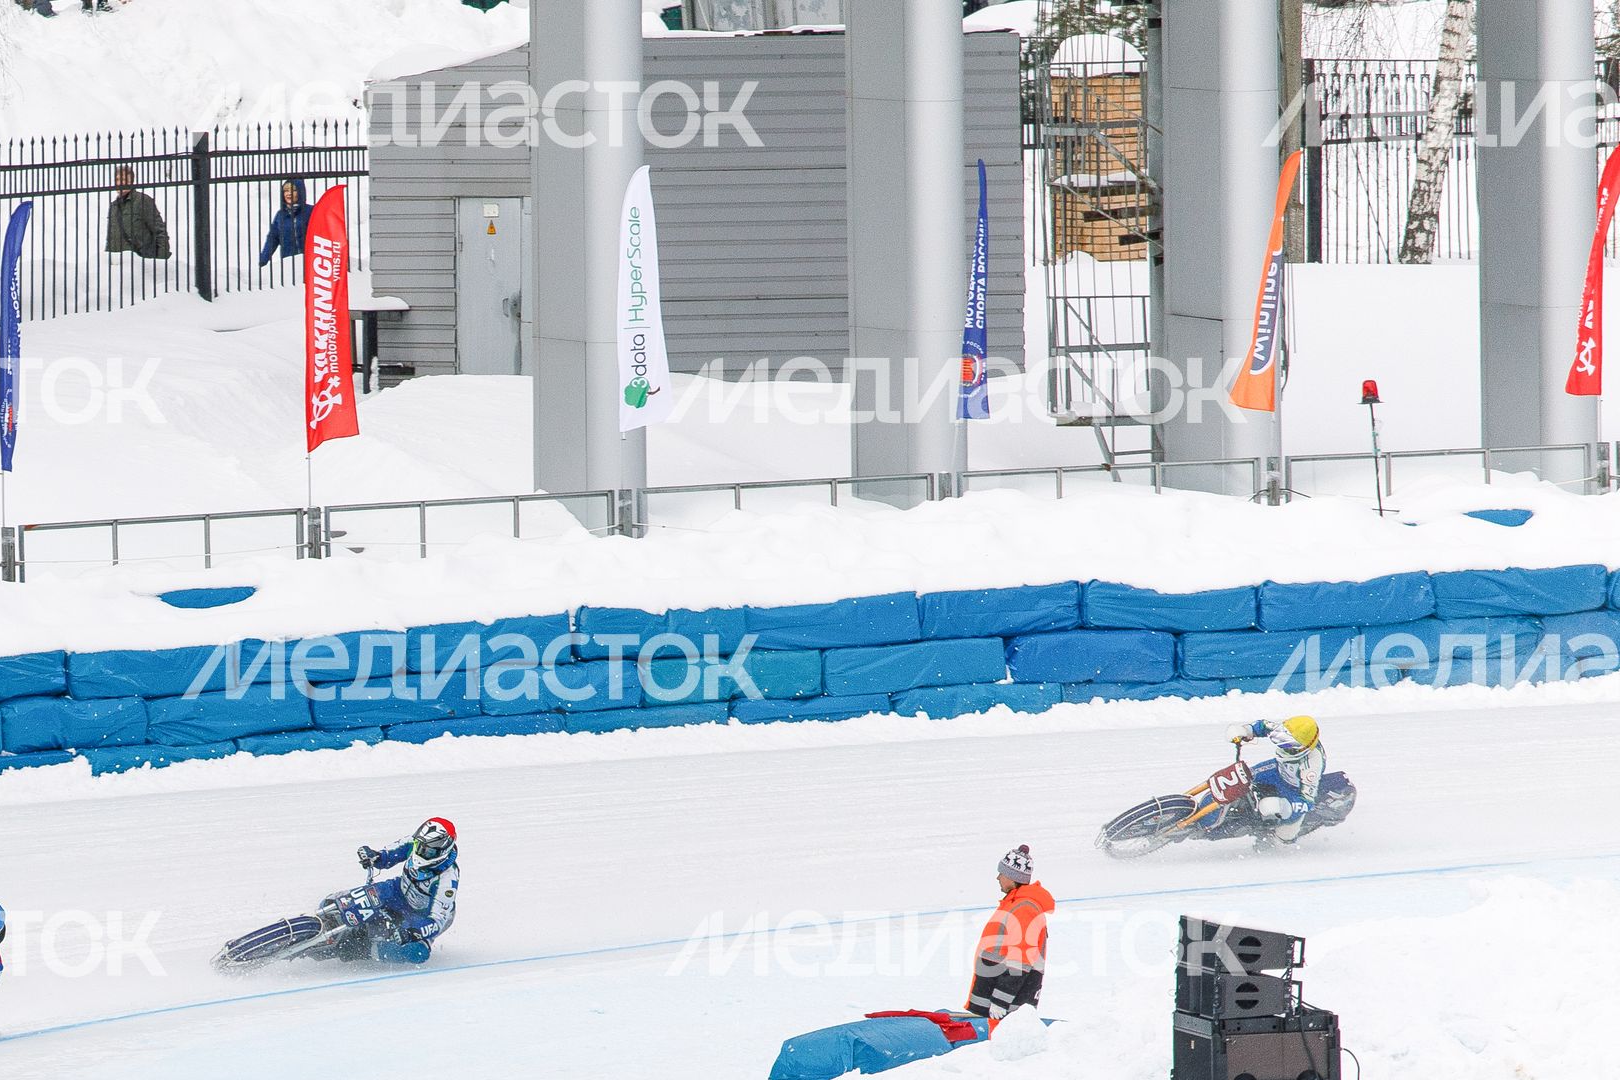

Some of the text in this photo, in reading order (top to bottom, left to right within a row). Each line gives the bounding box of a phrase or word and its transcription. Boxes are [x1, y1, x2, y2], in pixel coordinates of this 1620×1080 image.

[332, 241, 340, 282] yms.ru
[350, 887, 374, 921] UFA
[420, 922, 438, 937] UFA
